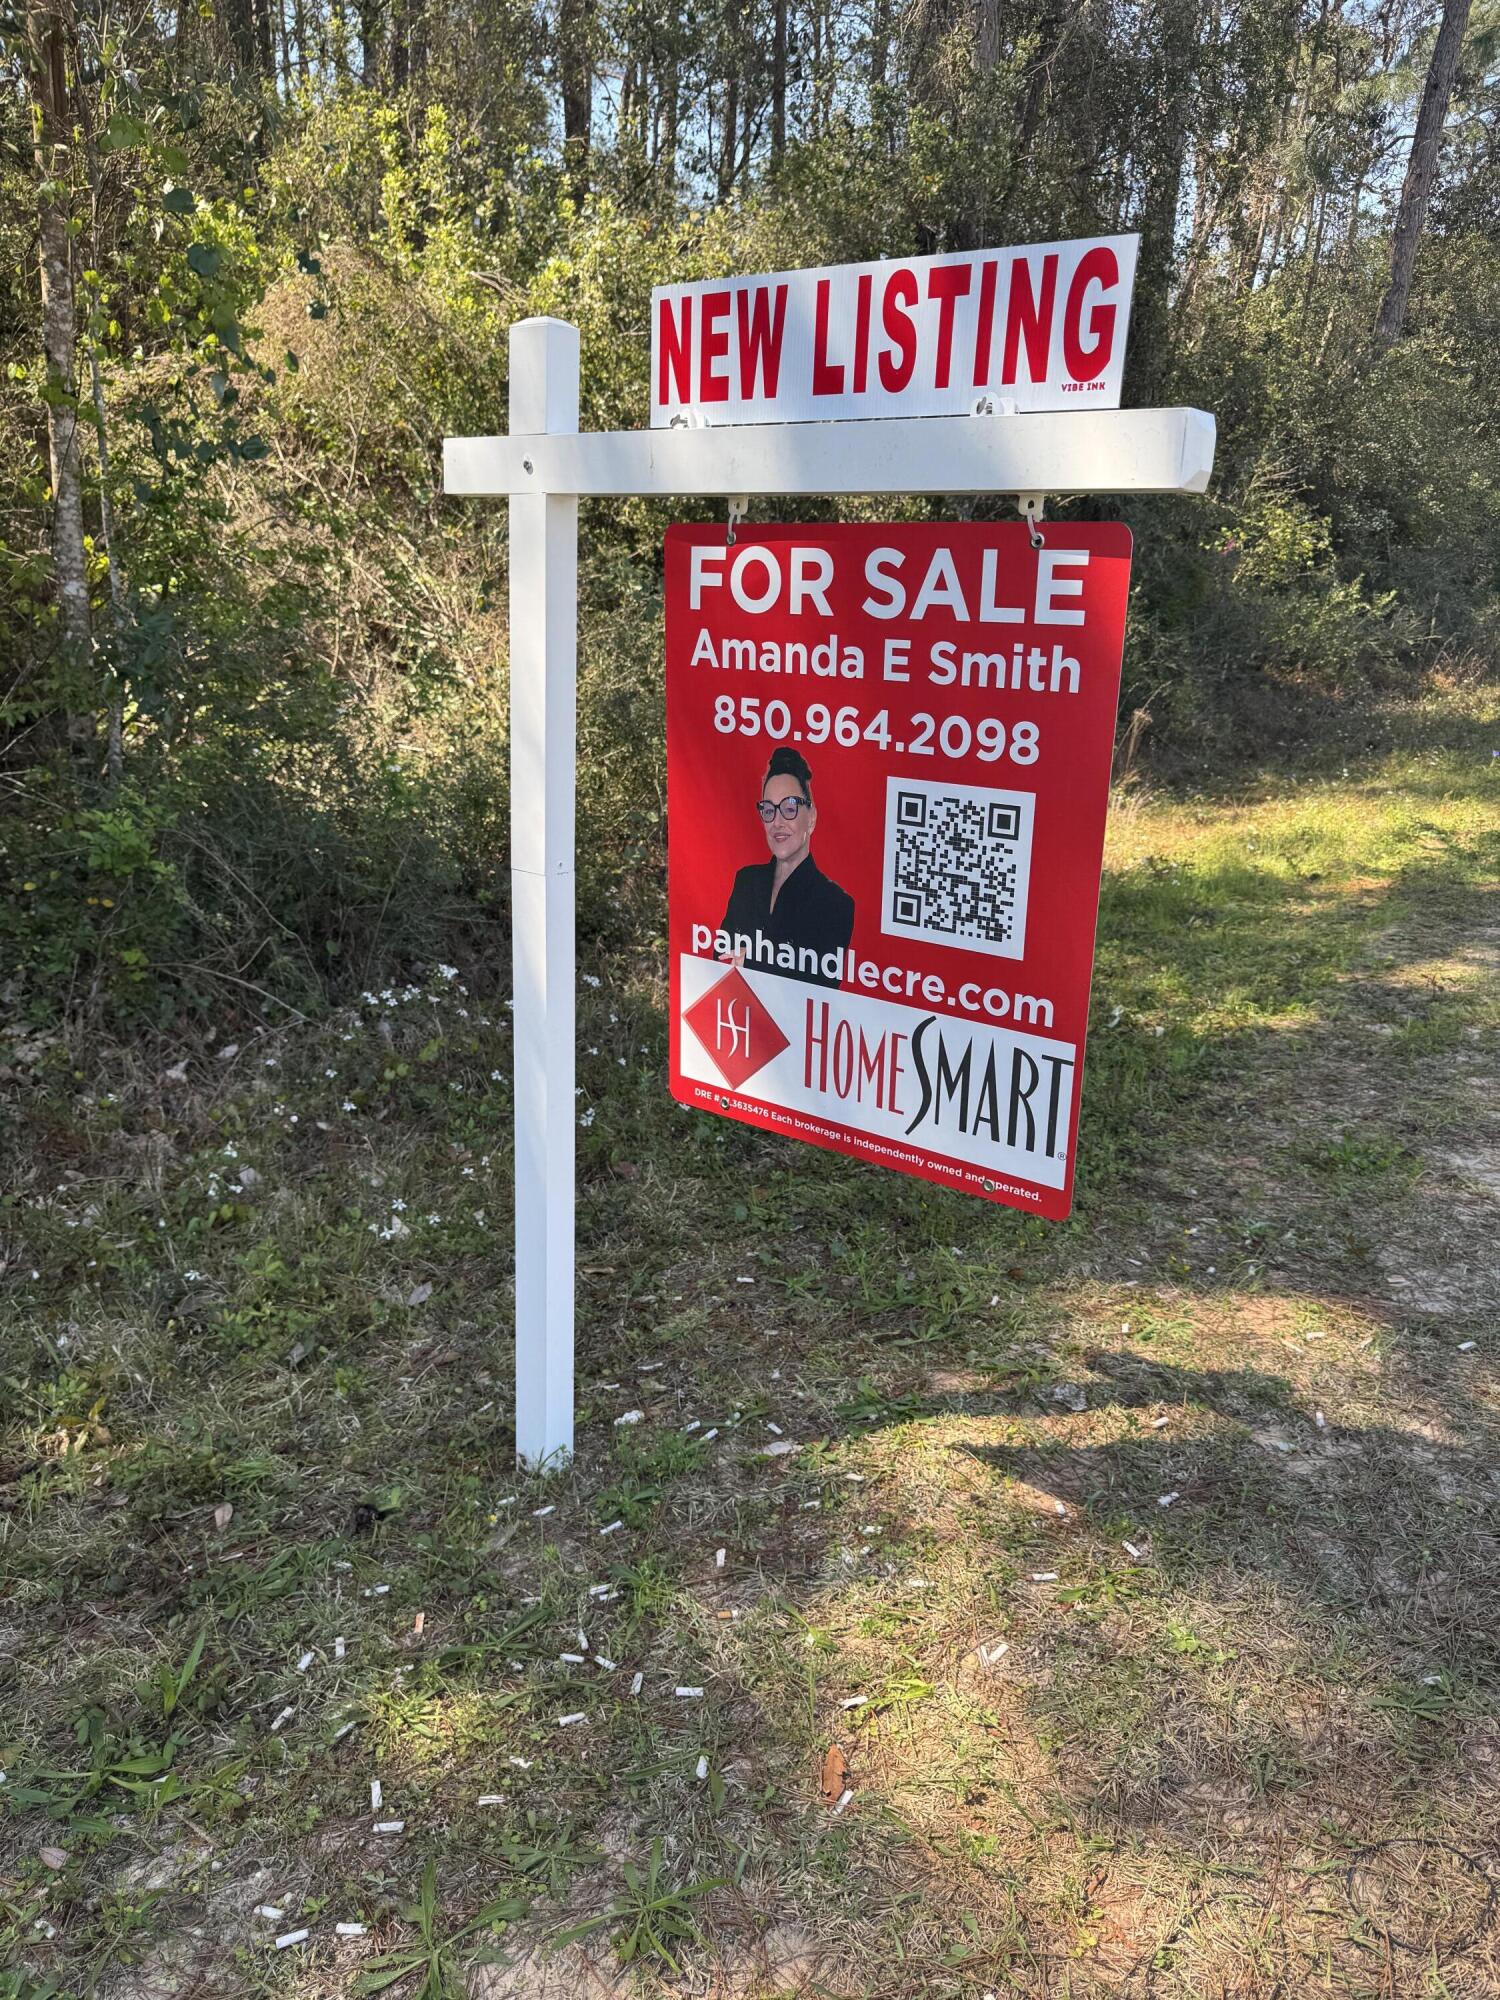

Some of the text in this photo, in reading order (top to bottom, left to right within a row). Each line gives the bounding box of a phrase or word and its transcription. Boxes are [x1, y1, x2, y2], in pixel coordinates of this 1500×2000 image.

[659, 247, 1120, 405] NEW LISTING
[1061, 382, 1106, 392] VIBE INK
[689, 546, 1090, 626] FOR SALE
[690, 628, 1081, 694] Amanda E Smith
[714, 695, 1040, 765] 850.964.2098
[691, 923, 1054, 1028] panhandlecre.com
[694, 1087, 712, 1100] DRE
[721, 1096, 769, 1117] L3635476
[771, 1112, 793, 1125] Each
[794, 1119, 841, 1141] brokerage
[843, 1131, 851, 1143] is
[853, 1137, 925, 1167] independently
[927, 1161, 962, 1178] owned
[965, 1172, 985, 1184] and
[985, 1179, 1042, 1203] perated.
